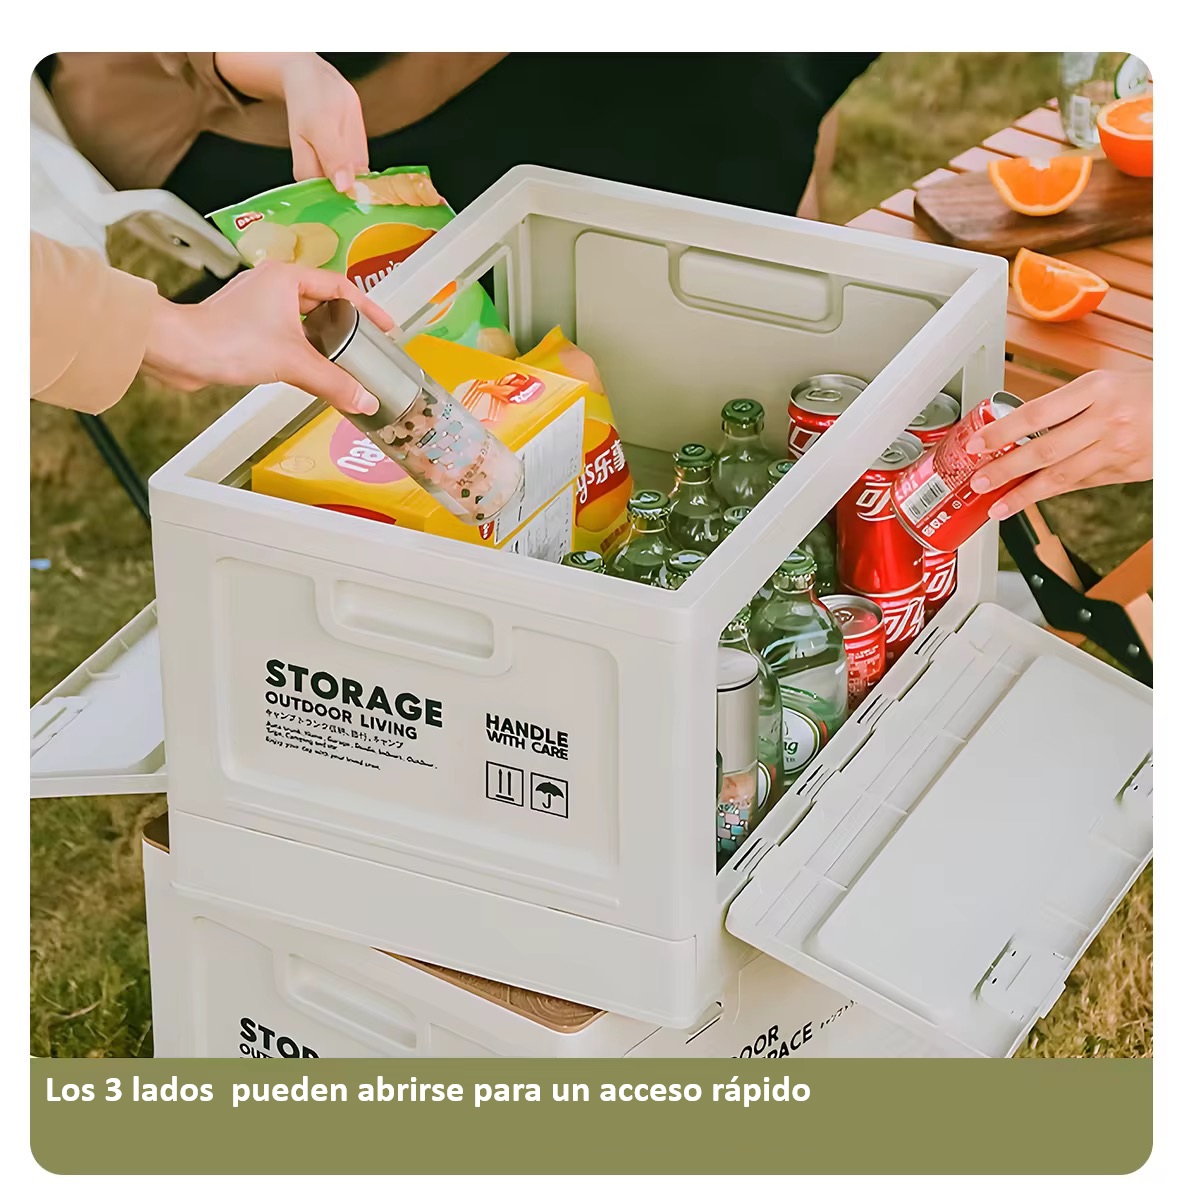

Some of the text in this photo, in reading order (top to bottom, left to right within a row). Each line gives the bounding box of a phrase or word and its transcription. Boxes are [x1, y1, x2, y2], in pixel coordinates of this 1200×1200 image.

[265, 658, 443, 728] STORAGE
[265, 690, 417, 740] OUTDOOR LIVING
[485, 713, 569, 747] HANDLE
[486, 728, 569, 760] WITH CARE
